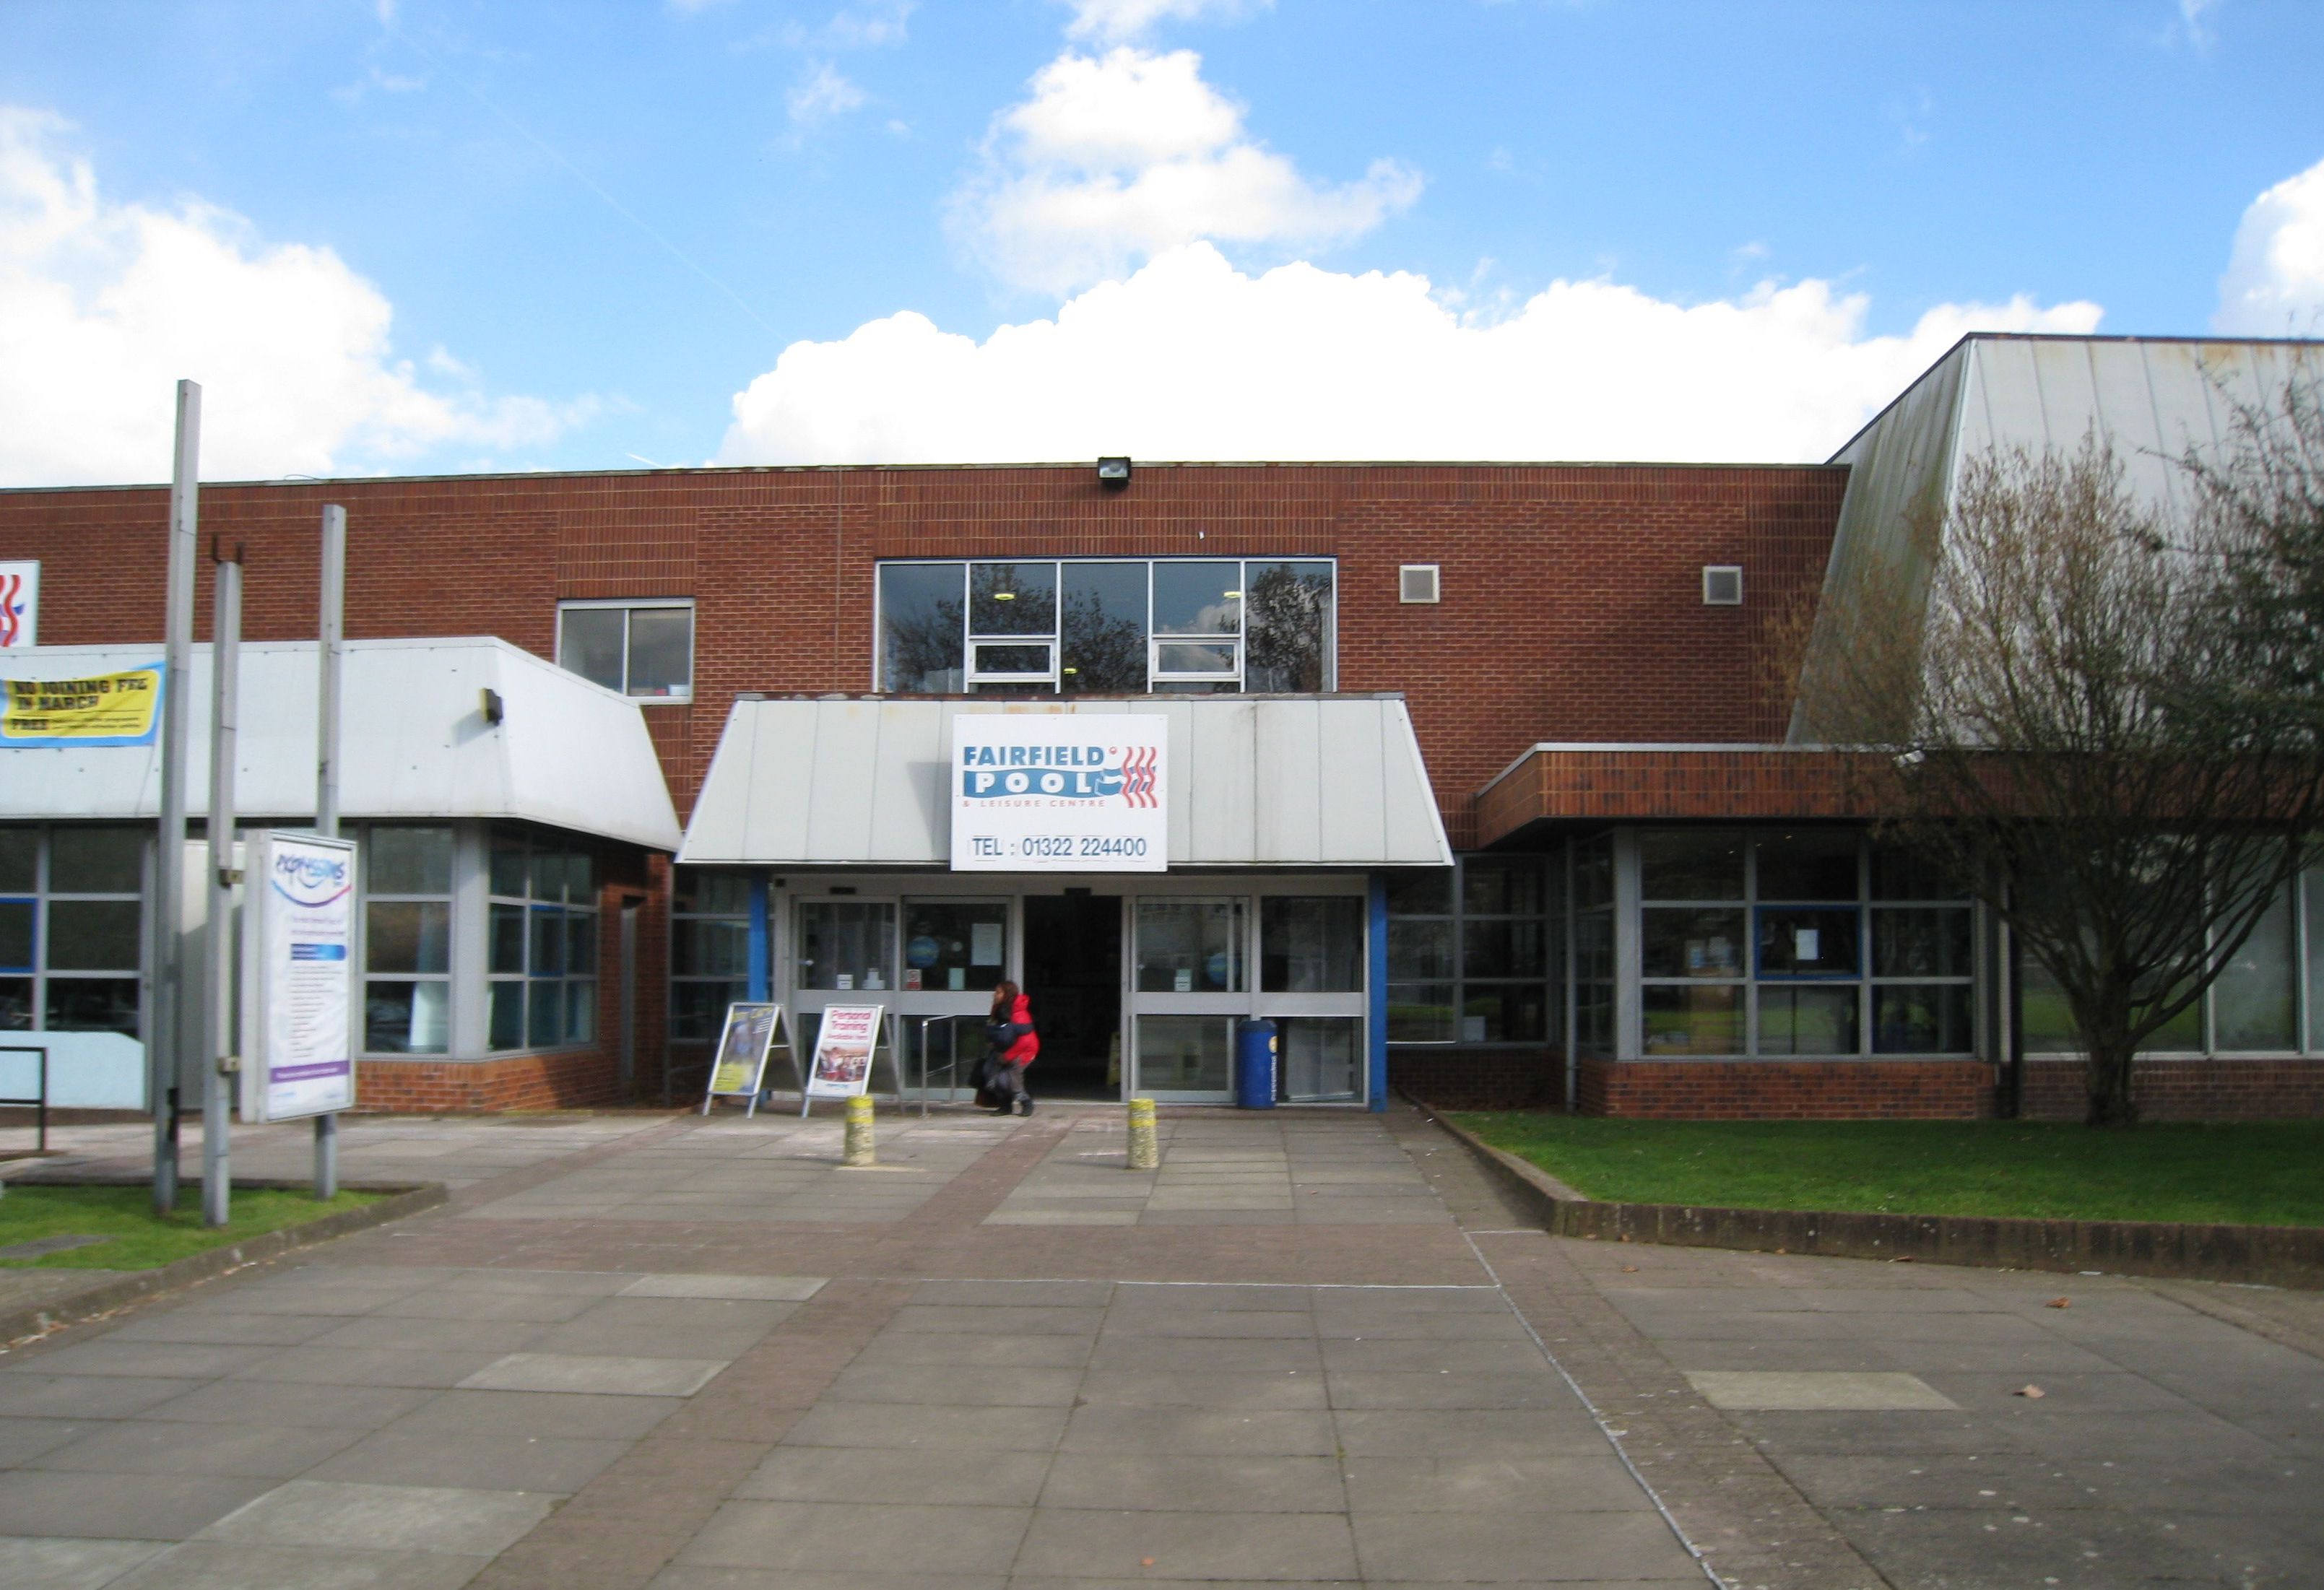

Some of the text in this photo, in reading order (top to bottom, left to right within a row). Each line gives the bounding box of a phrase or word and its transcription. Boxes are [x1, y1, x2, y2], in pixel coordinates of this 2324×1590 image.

[963, 746, 1105, 766] FAIRFIELD
[975, 772, 1093, 794] POOL
[1022, 837, 1072, 856] 01322
[1080, 837, 1146, 856] 224400
